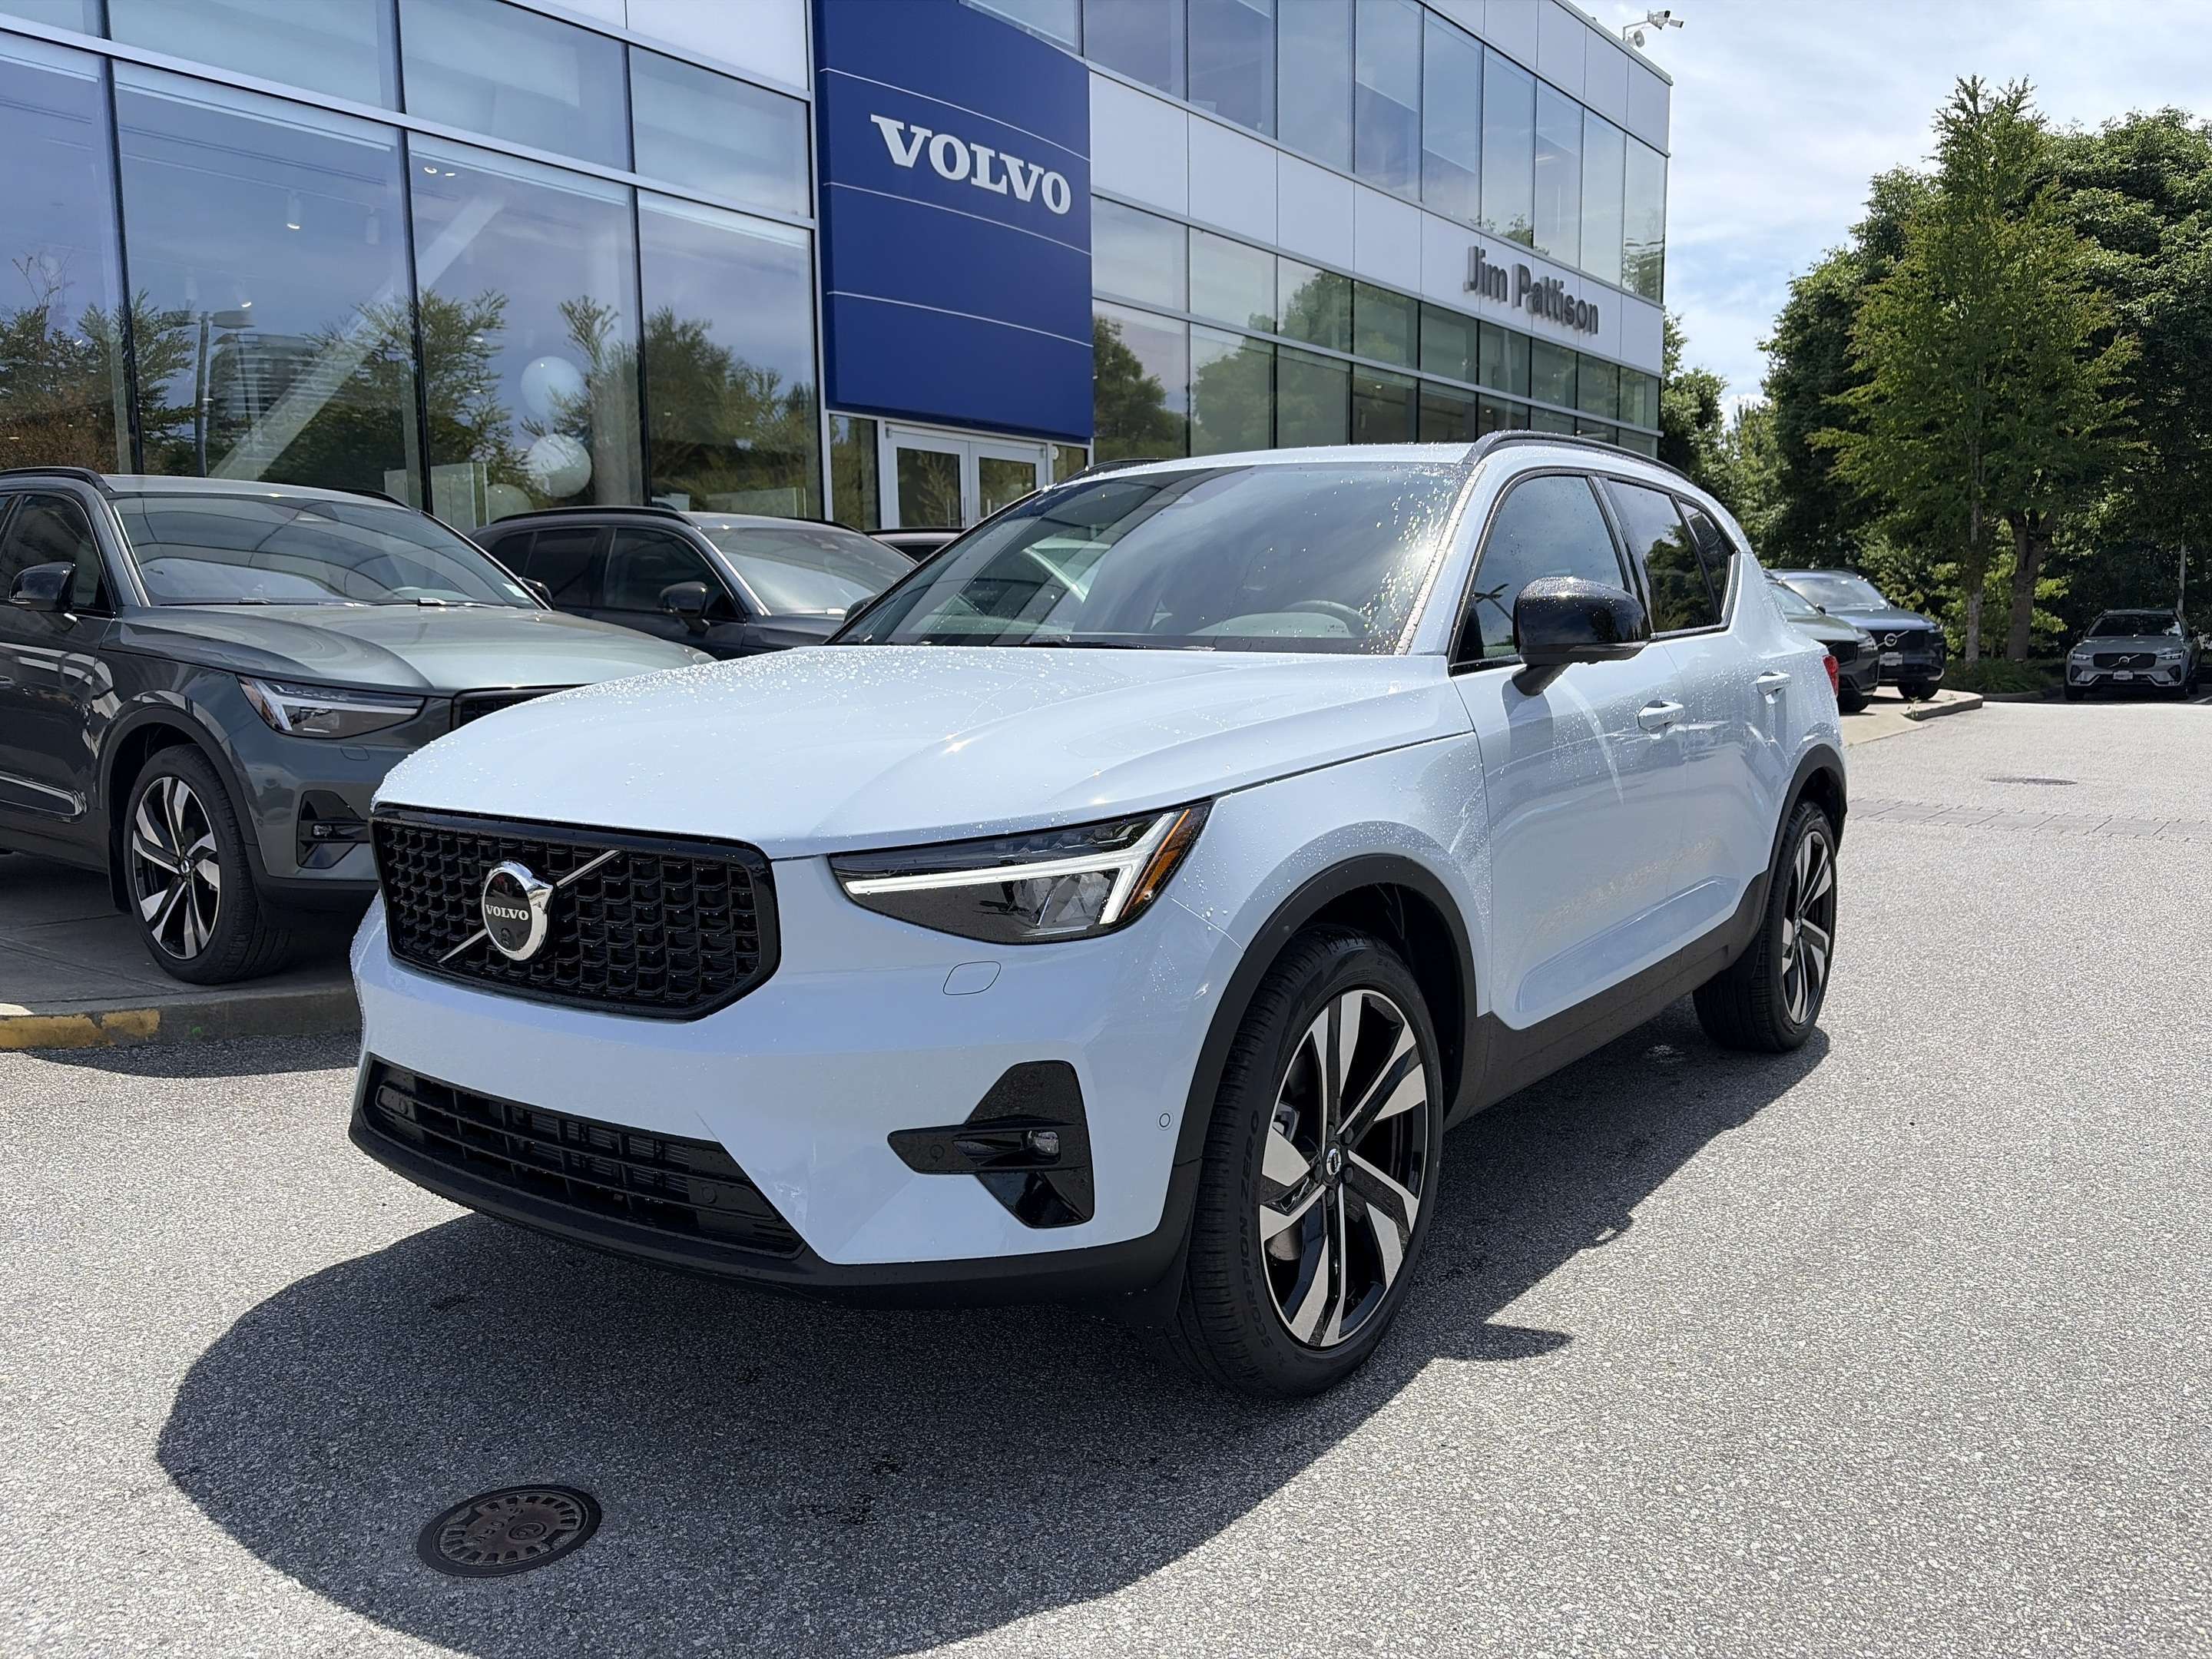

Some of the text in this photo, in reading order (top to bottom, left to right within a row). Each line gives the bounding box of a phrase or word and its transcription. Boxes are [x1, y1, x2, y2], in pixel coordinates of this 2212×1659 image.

[870, 114, 1071, 215] VOLVO
[1463, 246, 1599, 336] Jim Pattison
[485, 904, 529, 921] VOLVO
[1240, 1110, 1273, 1346] SCORPION ZERO
